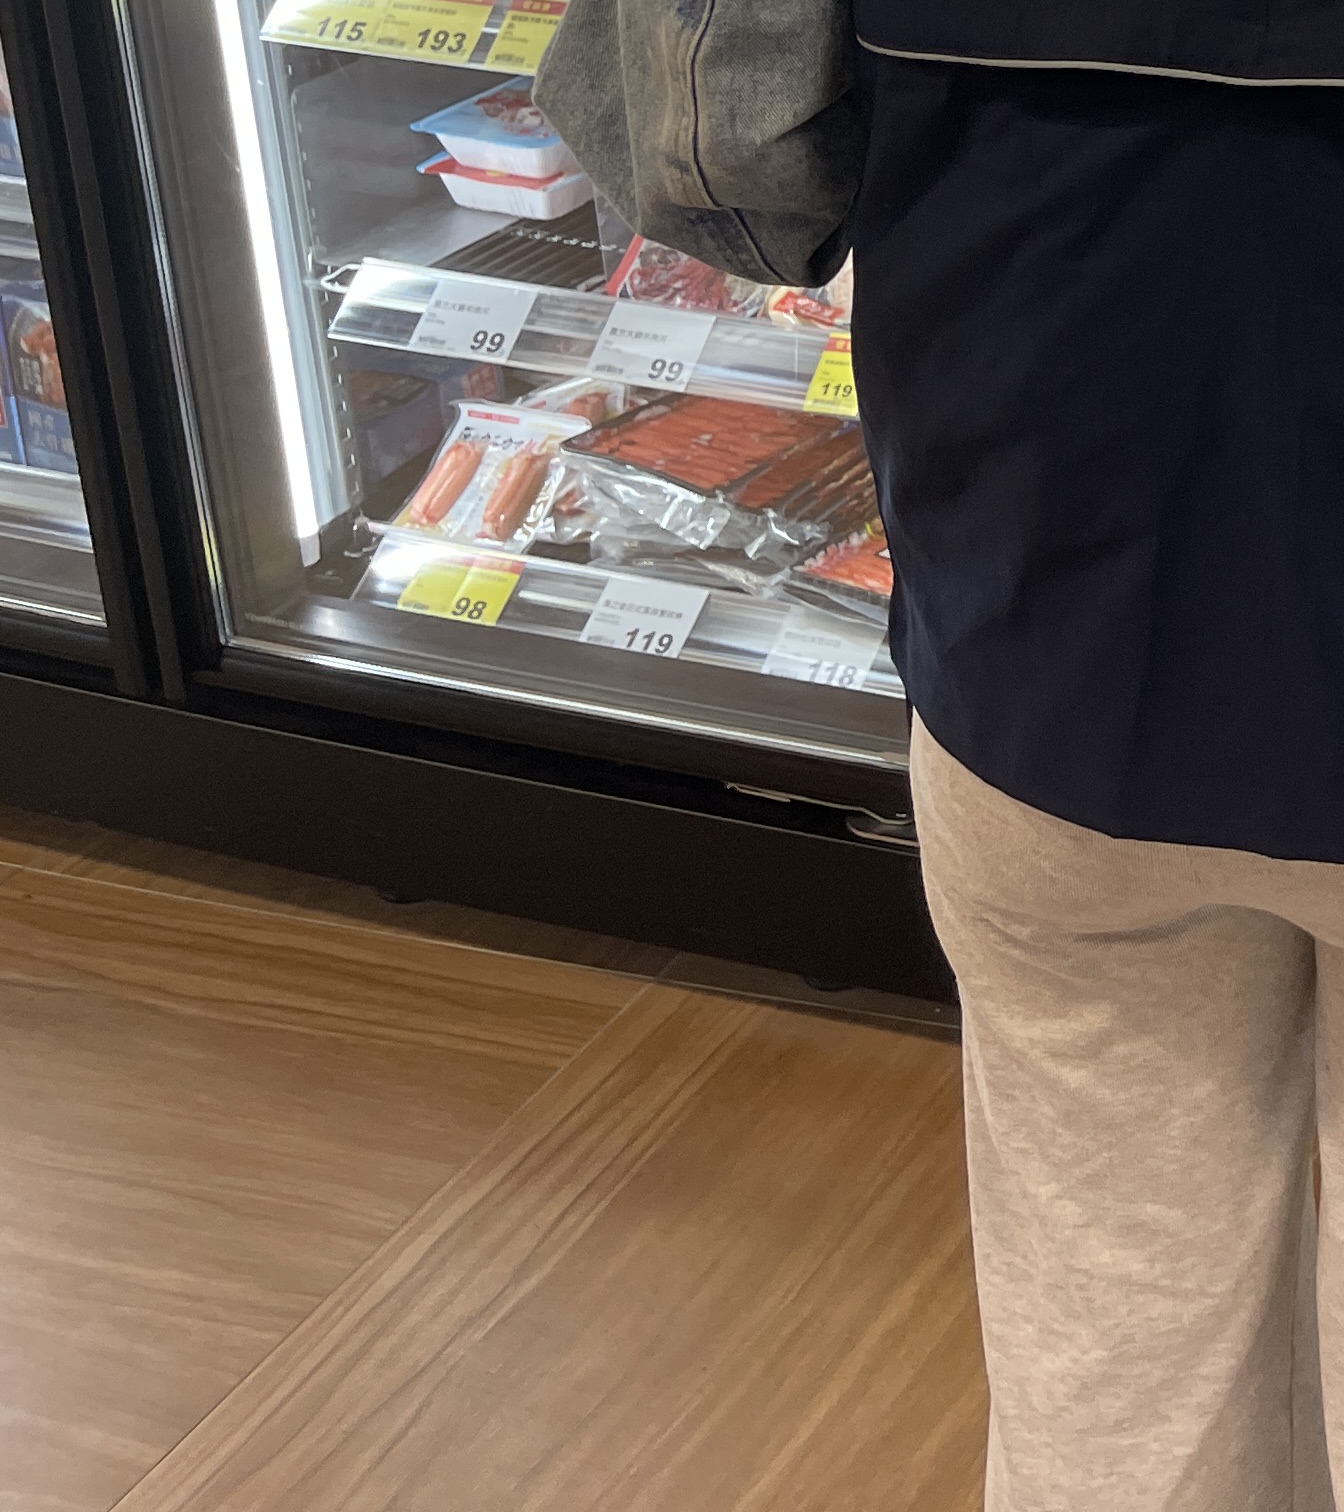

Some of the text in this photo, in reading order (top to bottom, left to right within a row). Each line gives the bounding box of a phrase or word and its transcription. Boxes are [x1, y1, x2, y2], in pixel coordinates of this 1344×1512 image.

[317, 17, 368, 42] 115
[417, 28, 467, 55] 193
[469, 330, 505, 353] 99
[646, 358, 684, 381] 99
[820, 383, 854, 399] 119
[450, 597, 489, 620] 98
[623, 627, 674, 656] 119
[806, 661, 859, 689] 118
